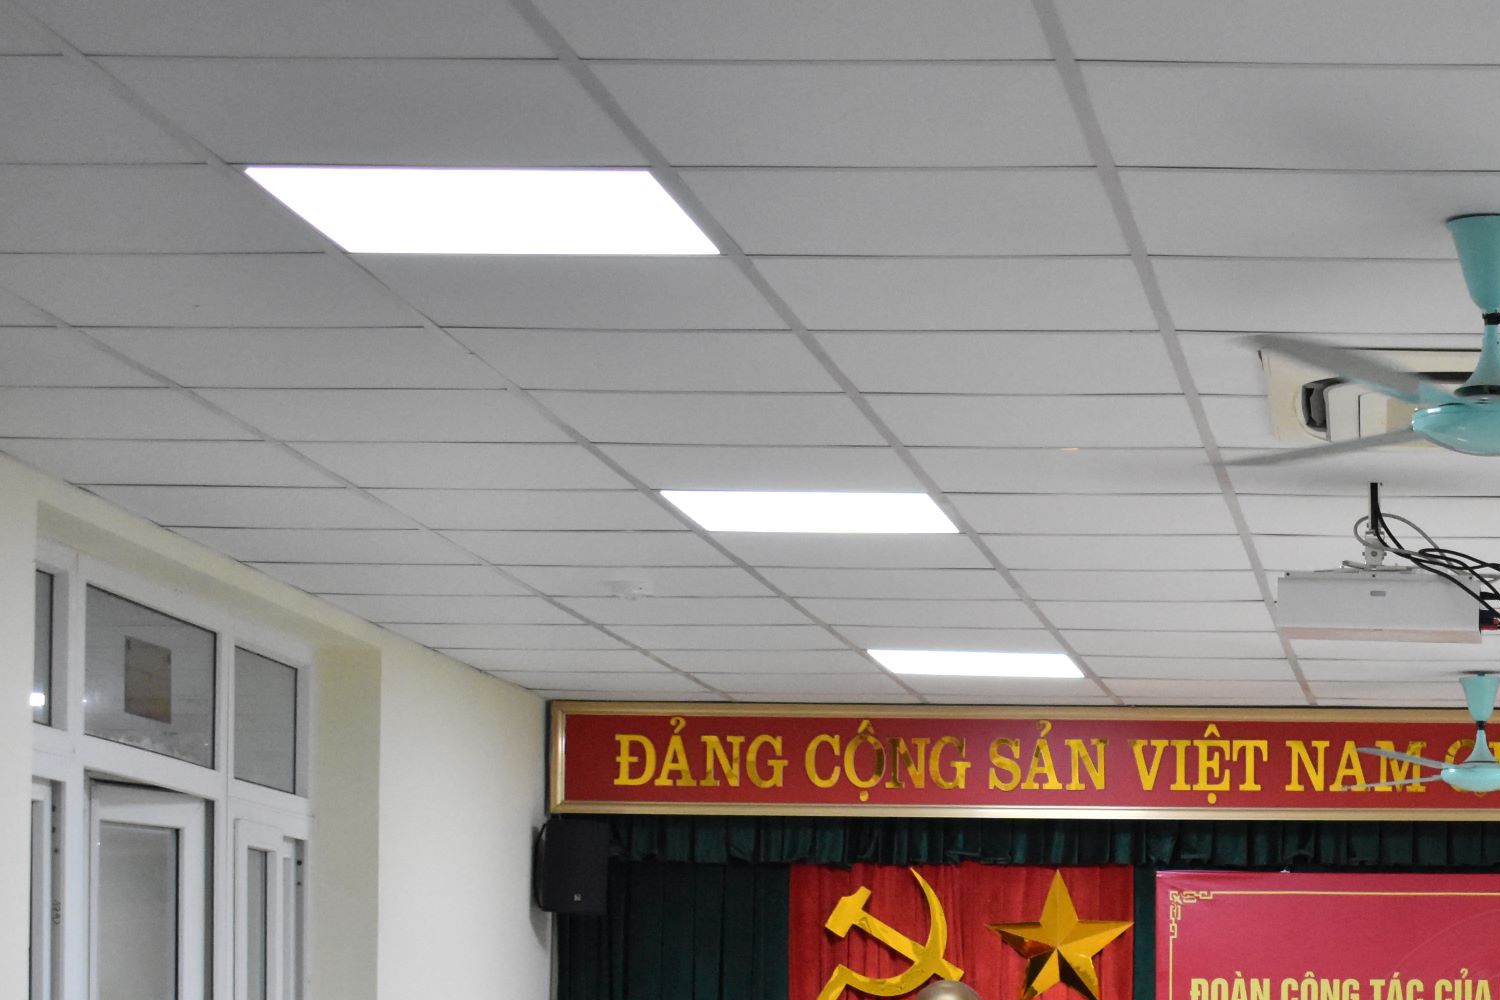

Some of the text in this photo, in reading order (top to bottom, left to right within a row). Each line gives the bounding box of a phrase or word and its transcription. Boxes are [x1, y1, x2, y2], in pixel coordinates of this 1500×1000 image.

[614, 716, 786, 789] ĐẢNG
[804, 719, 972, 801] CỘNG
[988, 720, 1108, 792] SẢN
[1131, 722, 1270, 804] VIỆT
[1286, 739, 1427, 793] NAM
